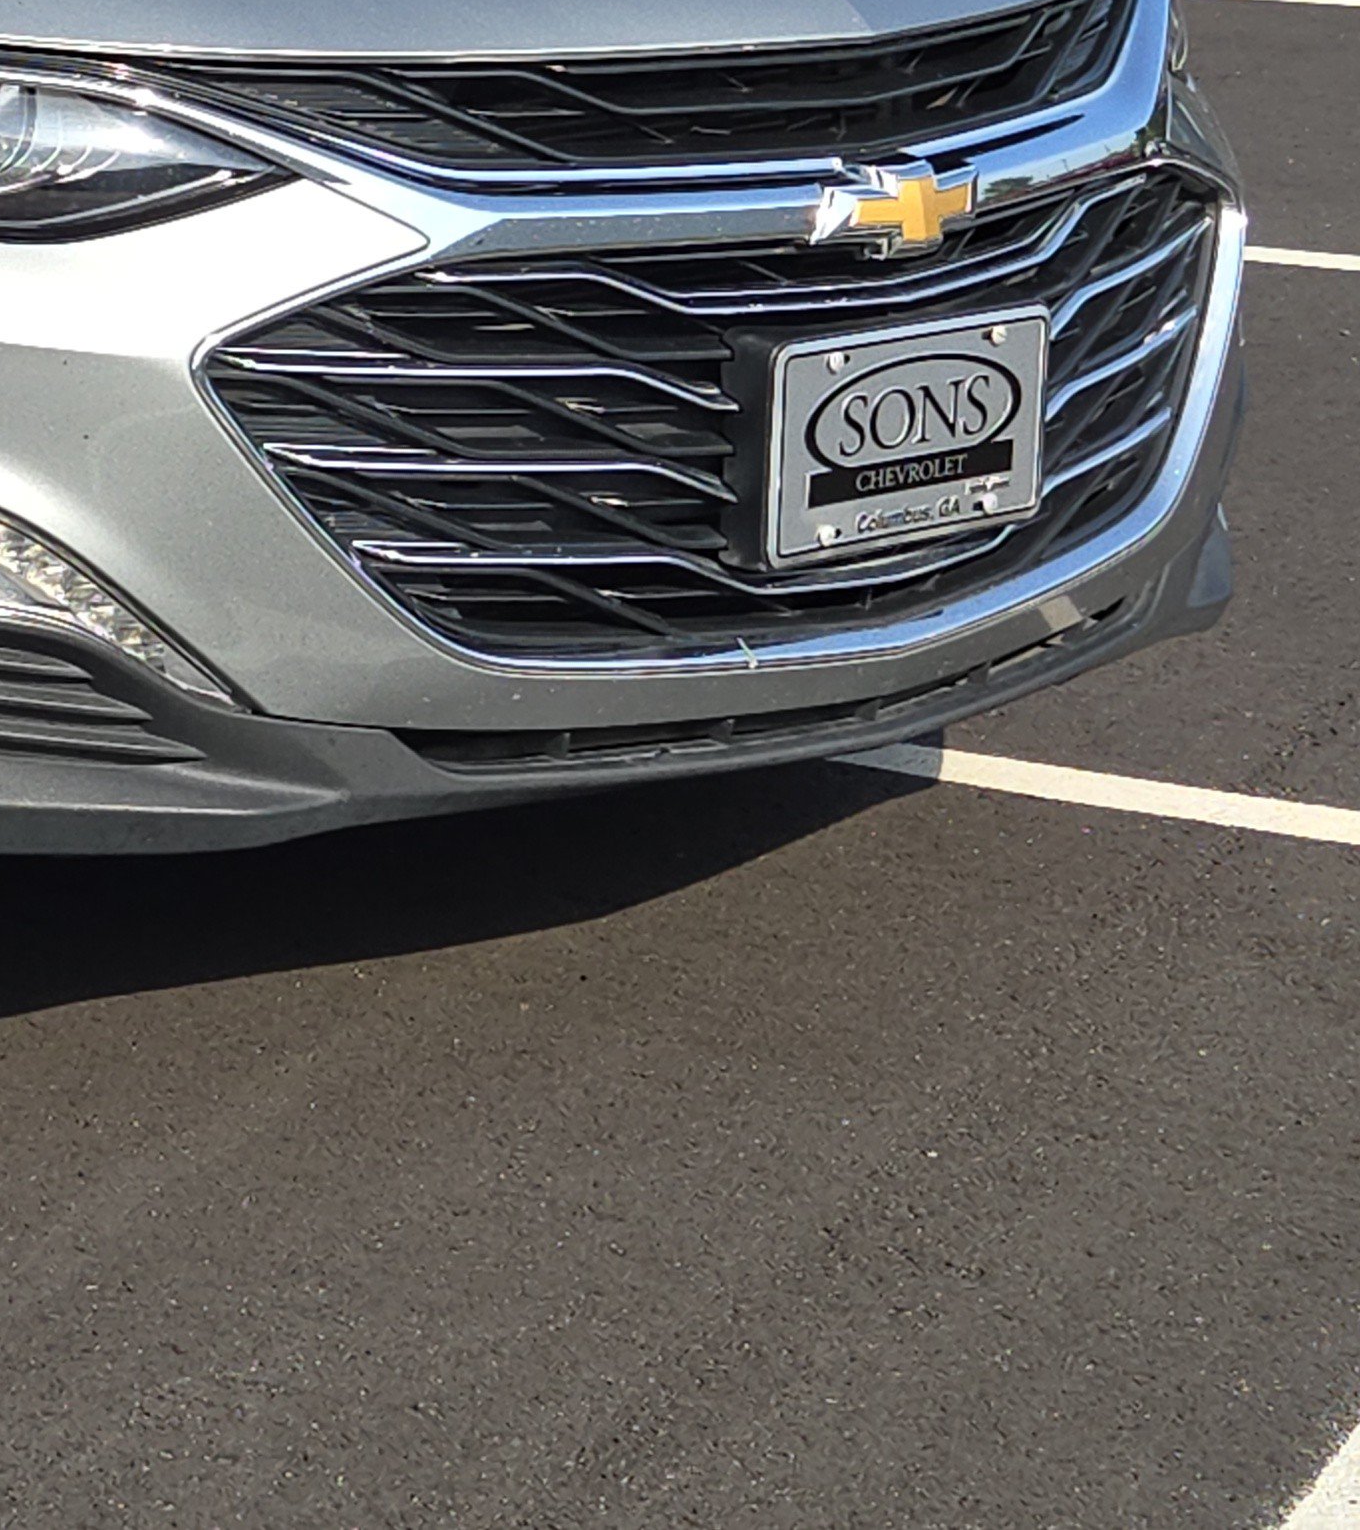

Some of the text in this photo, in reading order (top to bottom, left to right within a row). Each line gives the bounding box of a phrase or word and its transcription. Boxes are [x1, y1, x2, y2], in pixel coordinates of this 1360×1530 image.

[838, 373, 991, 458] SONS
[855, 453, 968, 492] CHEVROLET
[937, 495, 961, 518] GA
